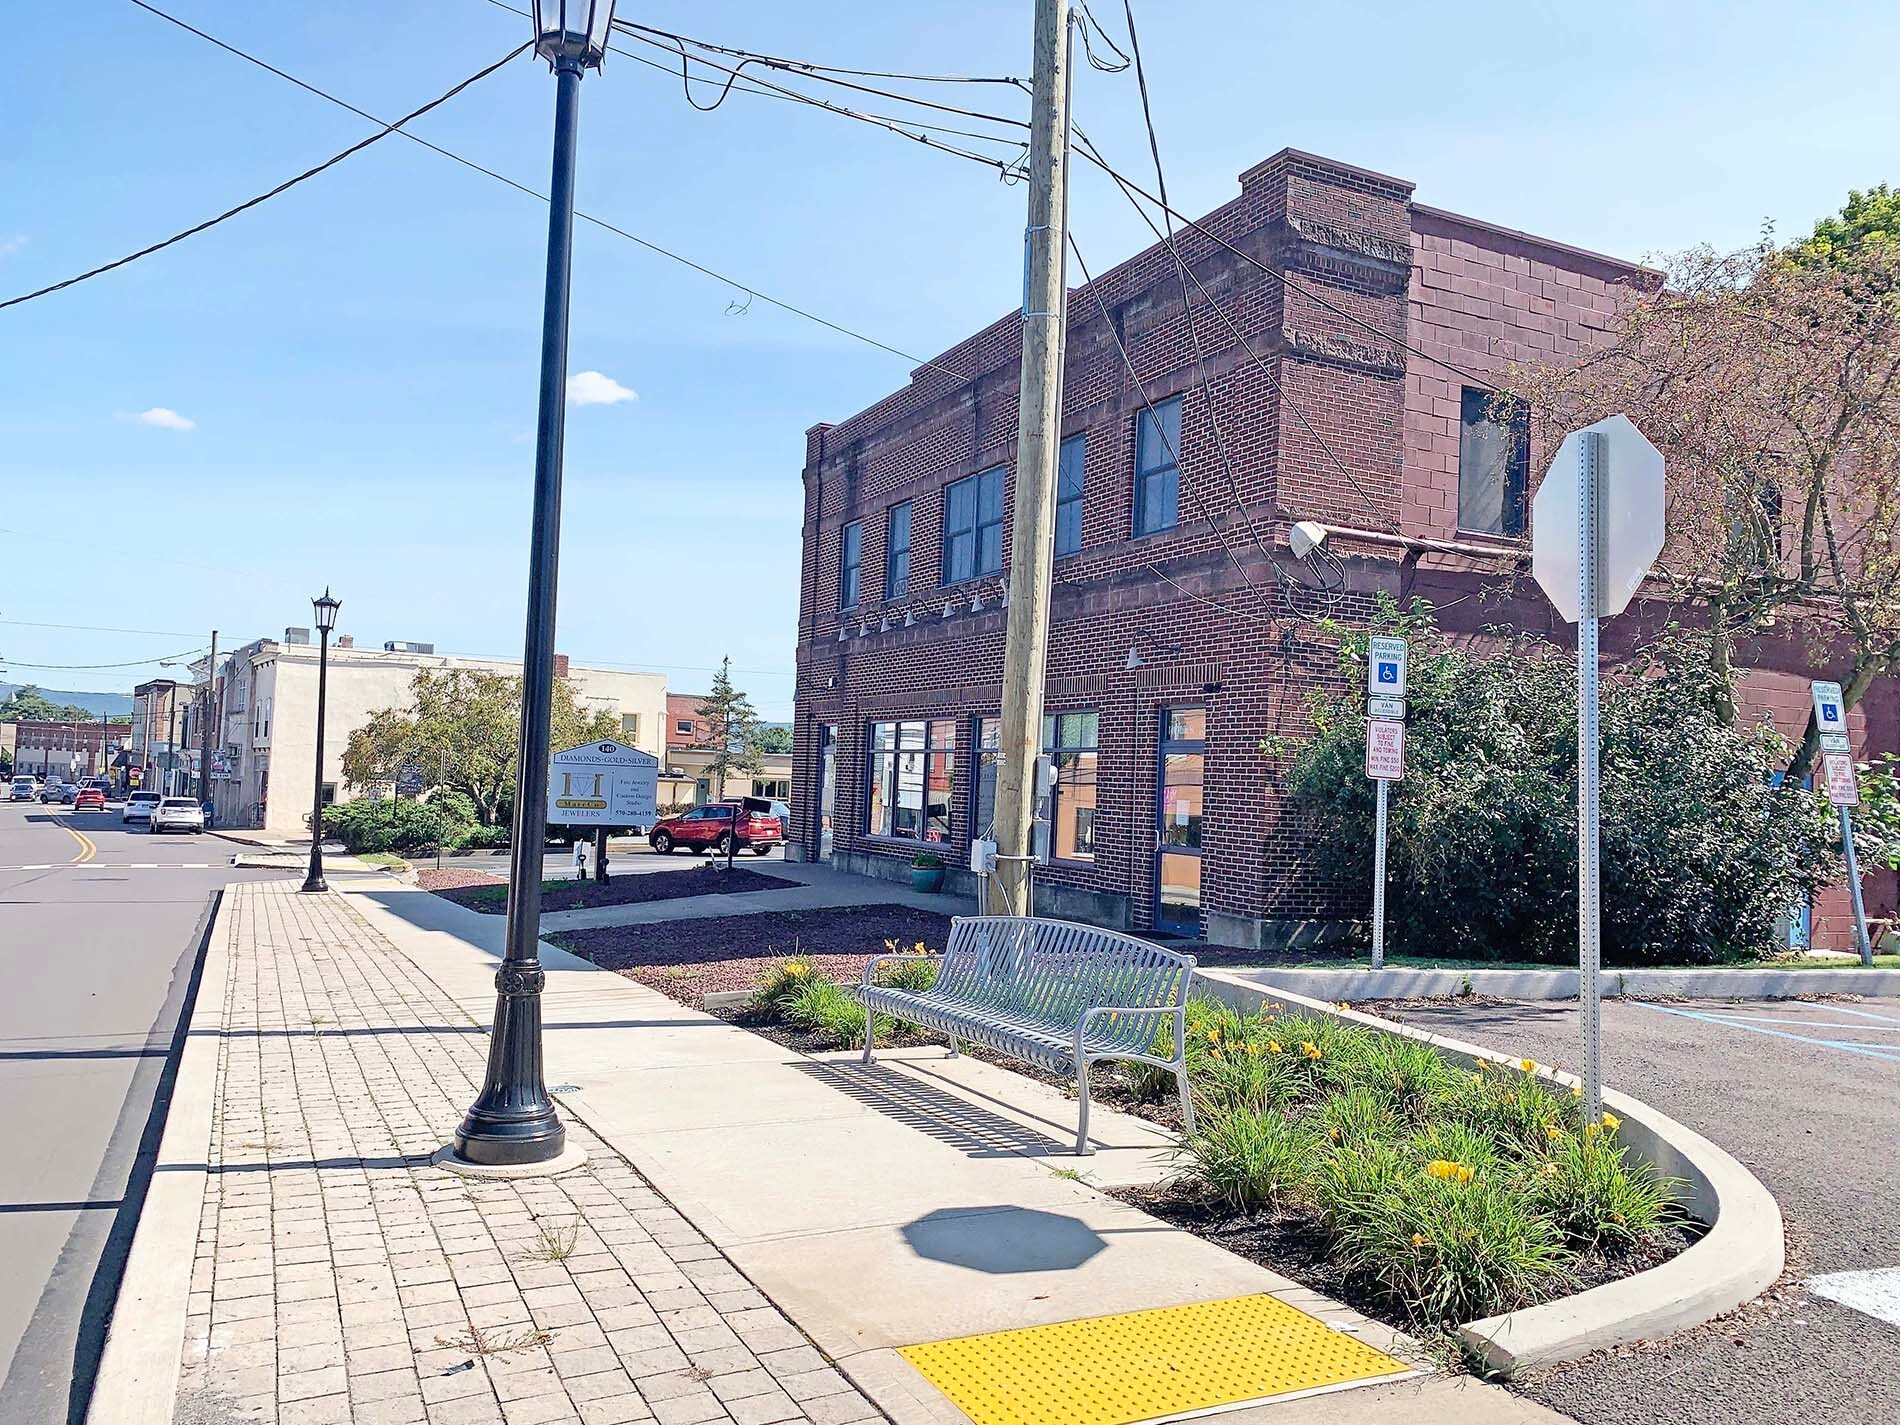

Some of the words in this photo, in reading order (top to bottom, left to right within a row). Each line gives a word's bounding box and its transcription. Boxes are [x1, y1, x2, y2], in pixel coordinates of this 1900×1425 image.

[1373, 641, 1405, 651] RESERVED
[1374, 652, 1402, 661] PARKING
[1375, 726, 1398, 734] VIOLATORS
